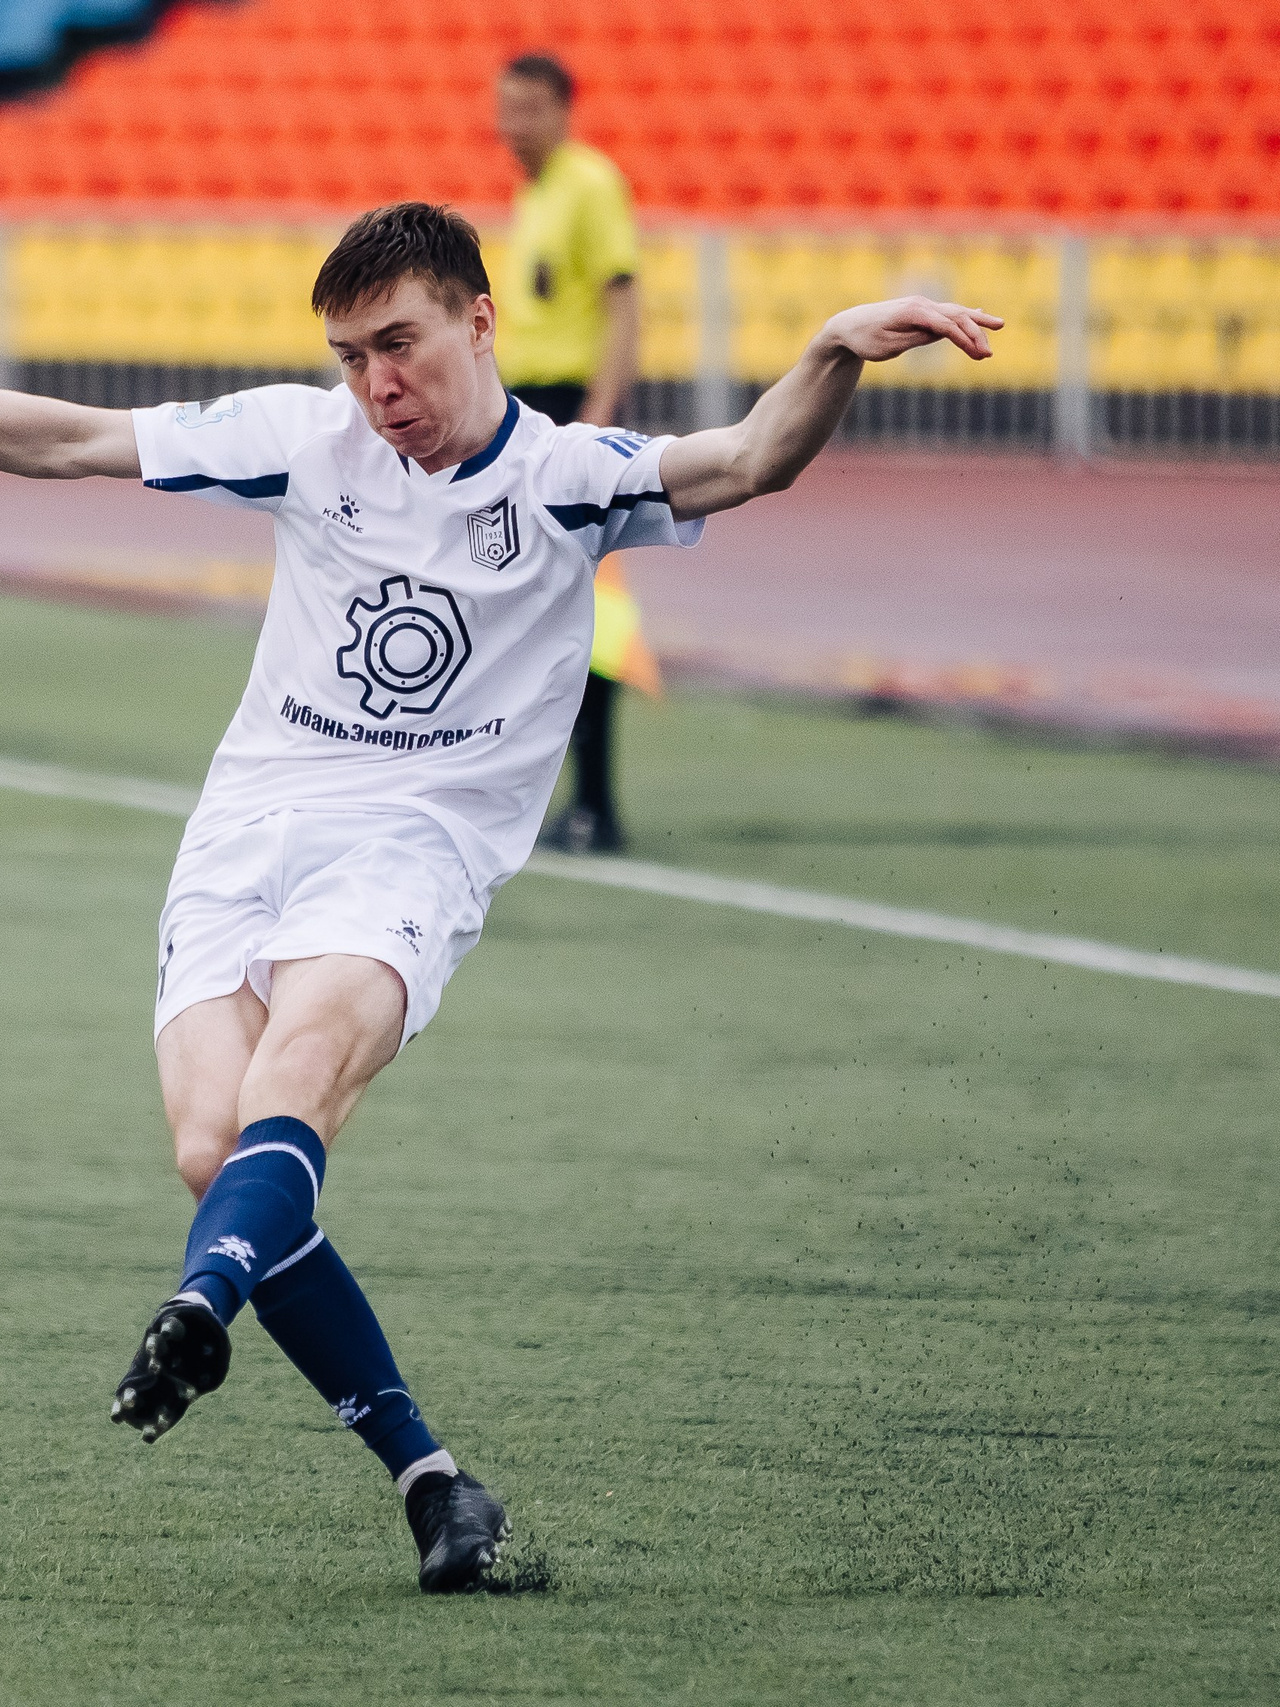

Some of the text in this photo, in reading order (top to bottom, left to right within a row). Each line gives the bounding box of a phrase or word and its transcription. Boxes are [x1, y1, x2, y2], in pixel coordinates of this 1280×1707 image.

[322, 507, 364, 534] KELME
[484, 530, 503, 540] 1932
[385, 927, 421, 957] KELME
